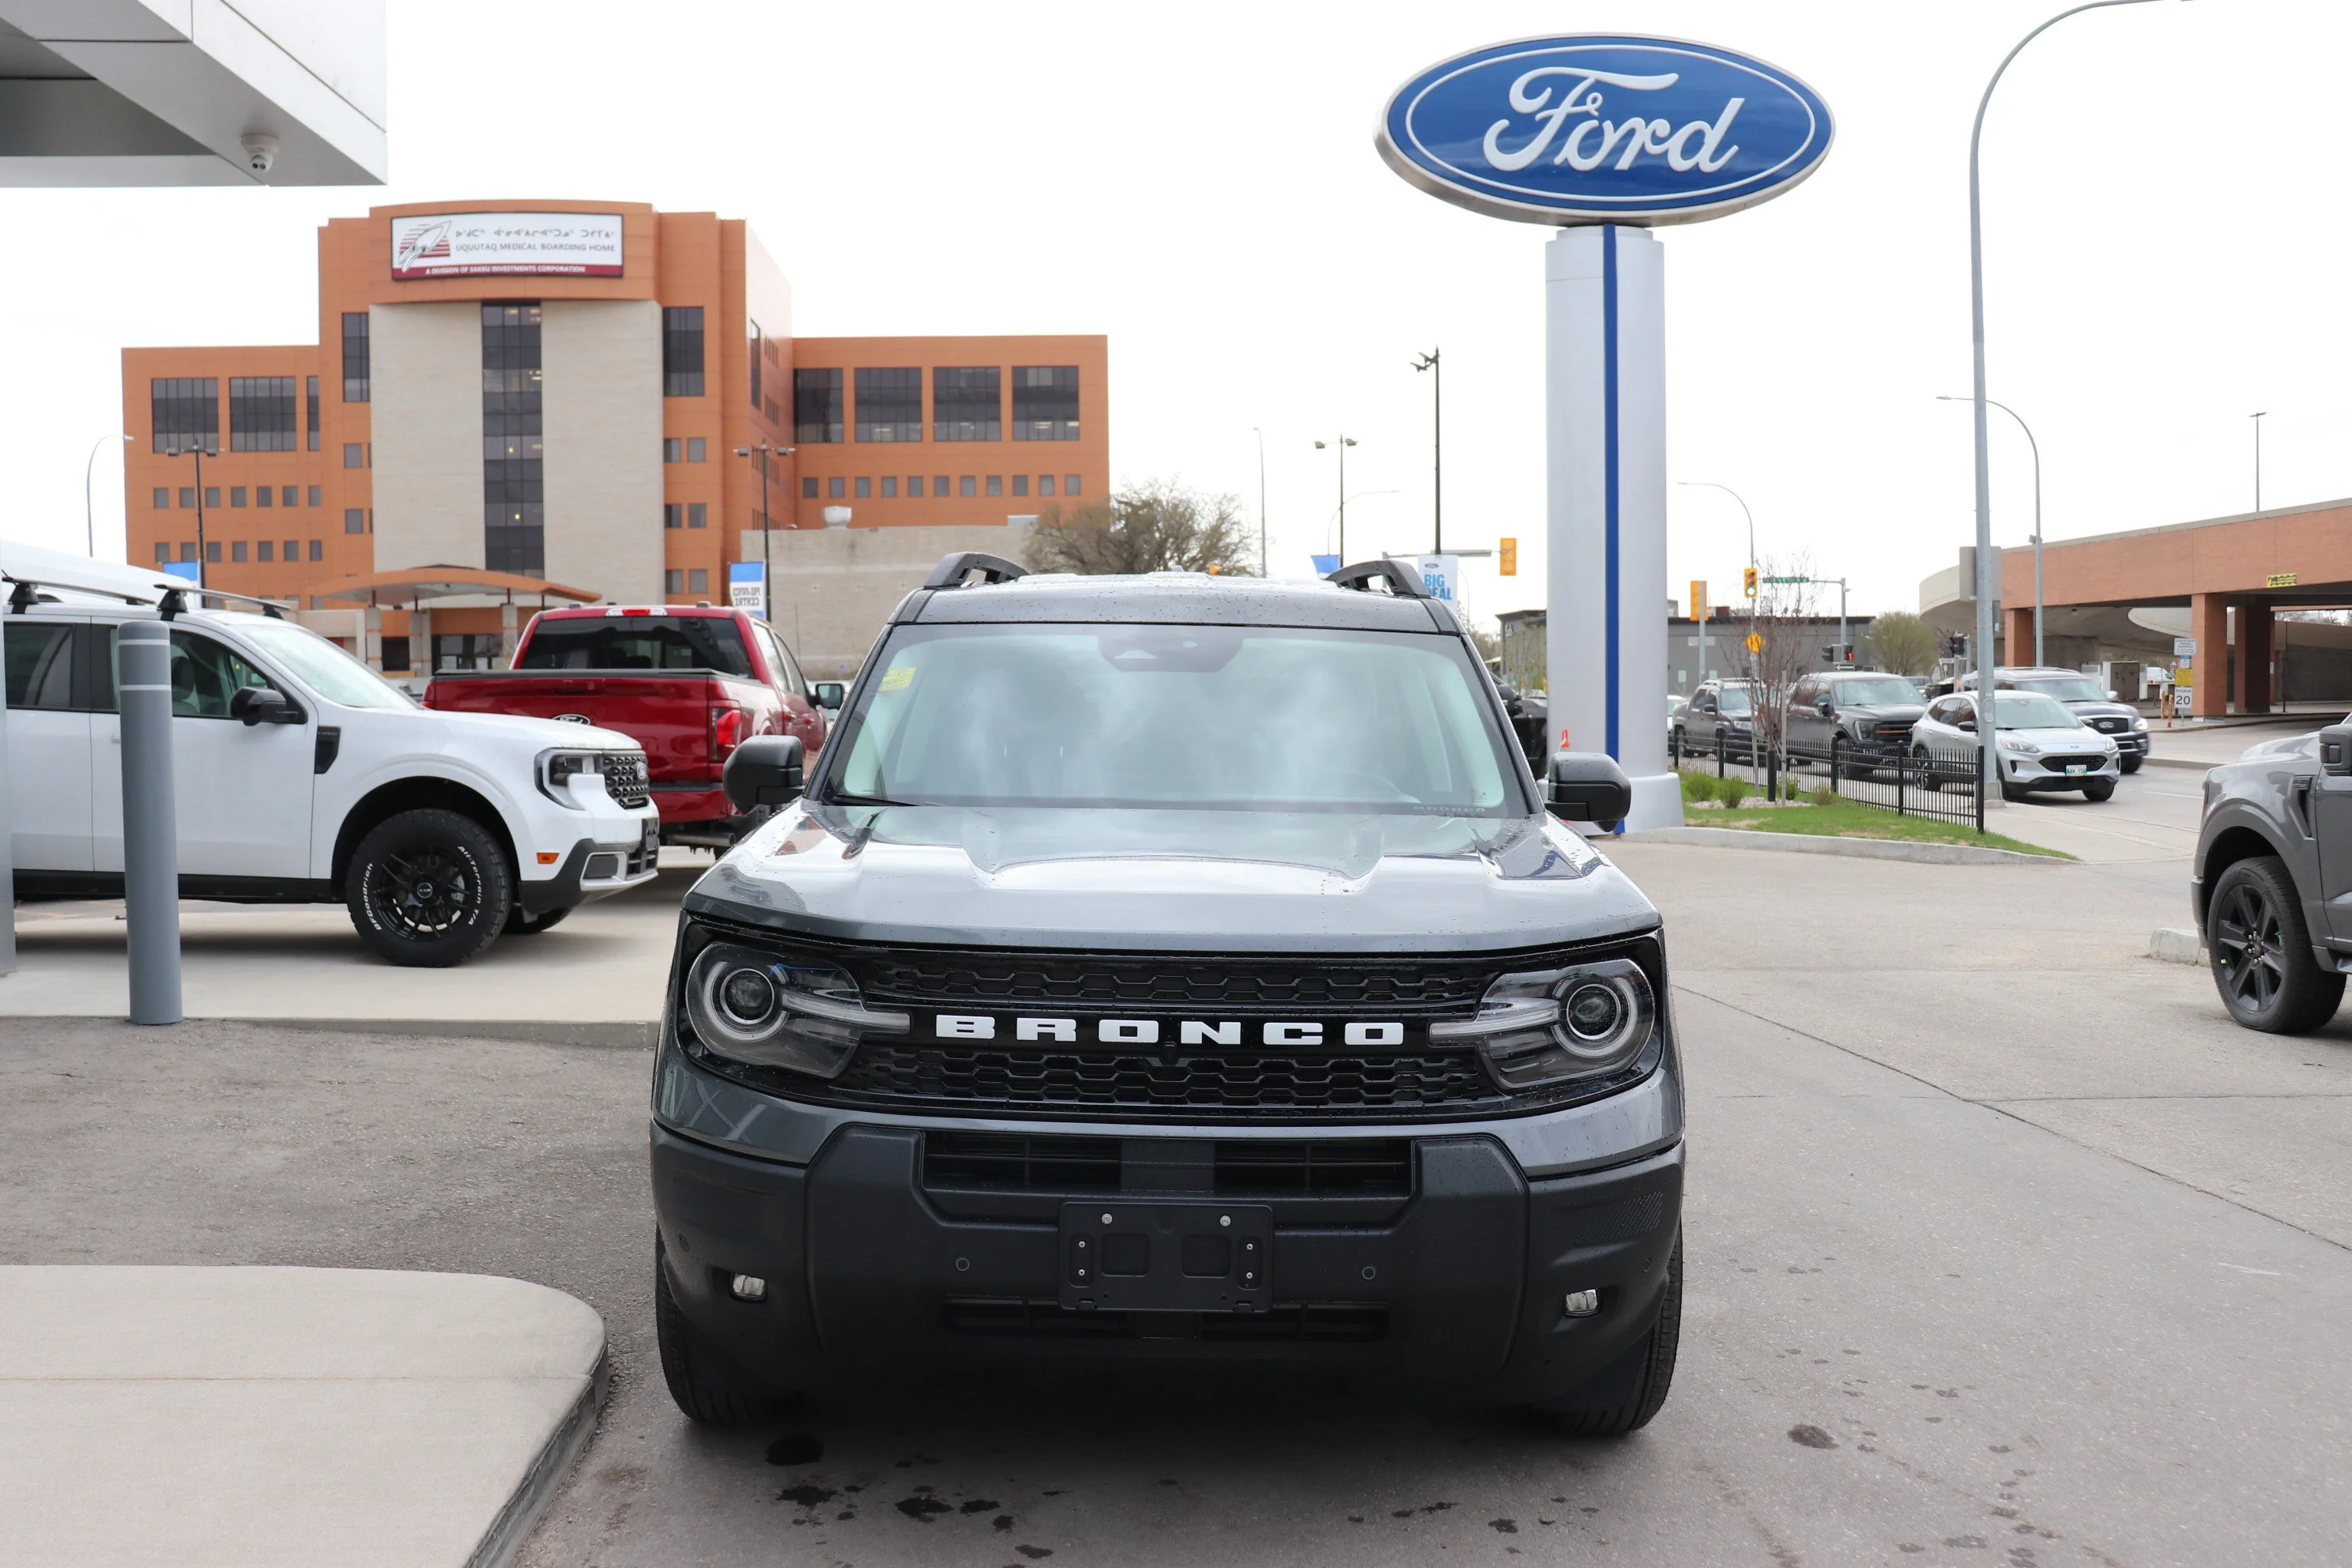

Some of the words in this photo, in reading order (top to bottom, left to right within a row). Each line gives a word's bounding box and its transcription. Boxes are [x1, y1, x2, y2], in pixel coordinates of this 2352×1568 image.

[1483, 66, 1746, 172] Ford
[456, 243, 497, 252] UQUUTAQ
[1424, 574, 1445, 587] BIG
[1428, 587, 1452, 600] EAL
[2176, 695, 2191, 705] 20
[362, 863, 382, 931] BFGoodrich
[936, 1014, 1404, 1046] BRONCO
